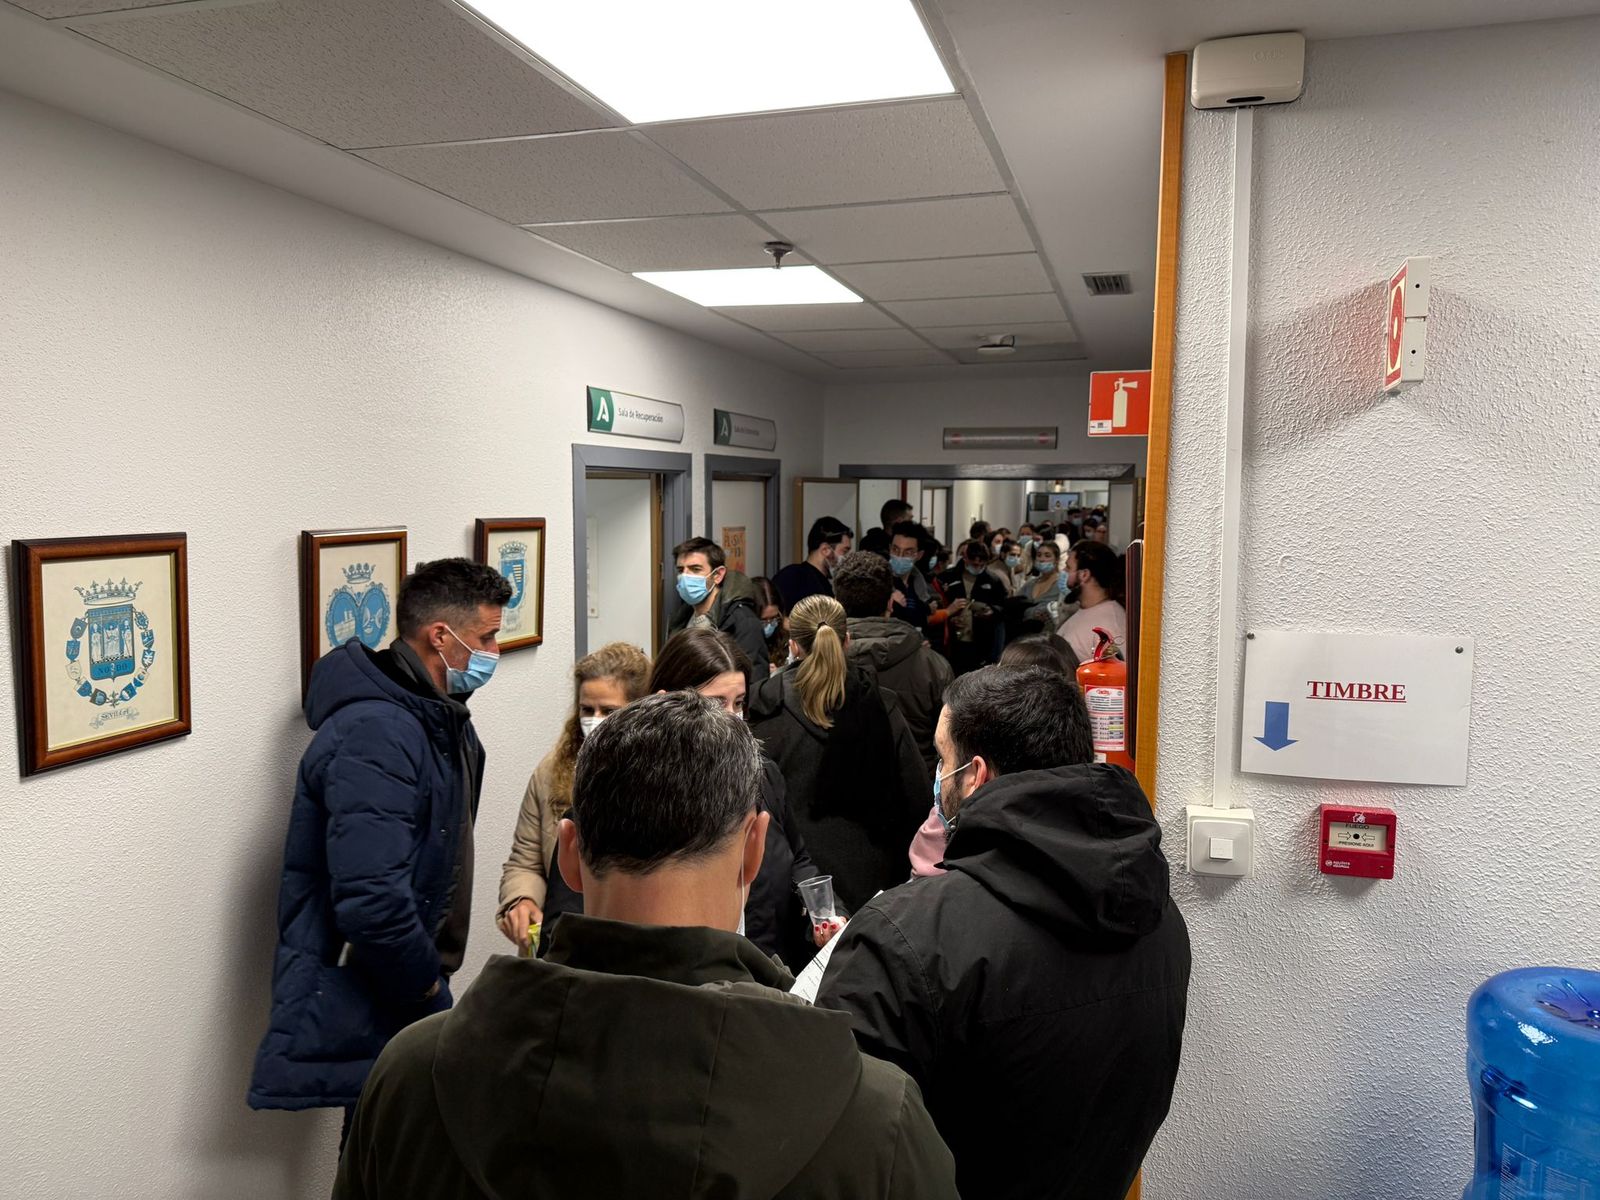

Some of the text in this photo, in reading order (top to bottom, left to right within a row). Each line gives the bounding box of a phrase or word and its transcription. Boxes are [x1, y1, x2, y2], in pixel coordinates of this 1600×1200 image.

[617, 407, 629, 418] Sala
[635, 410, 664, 423] Recuperación
[1306, 680, 1406, 702] TIMBRE
